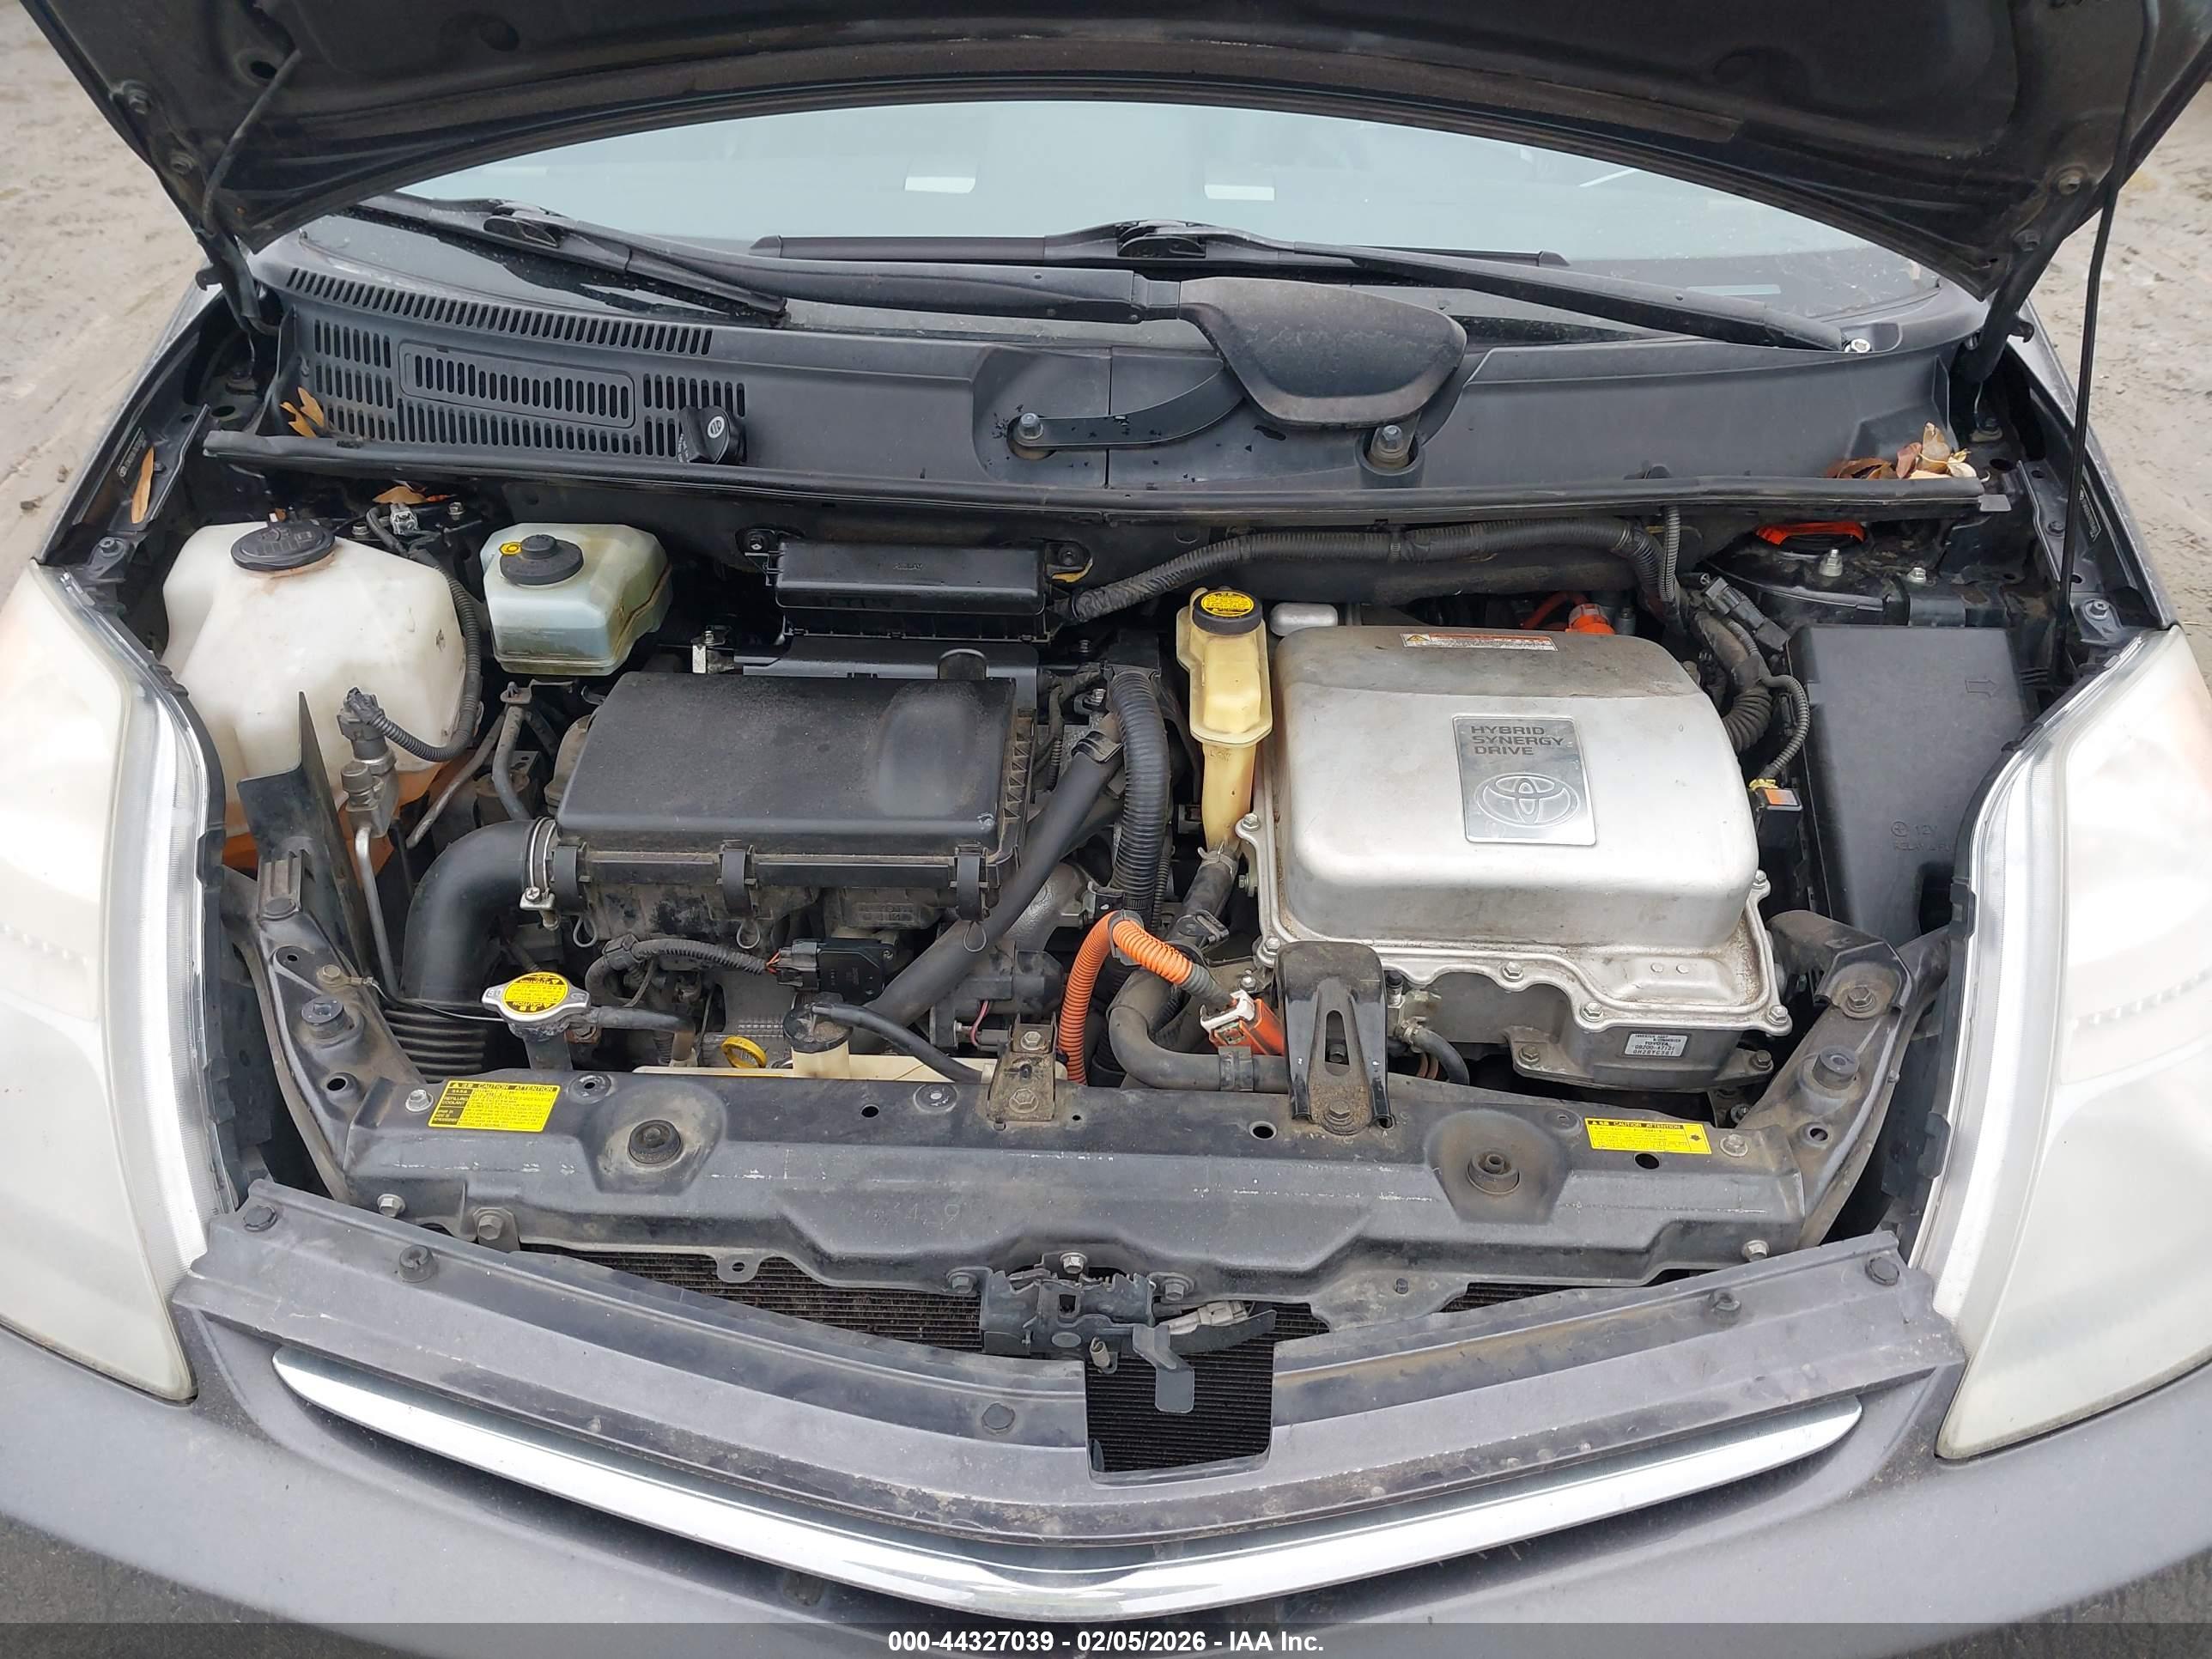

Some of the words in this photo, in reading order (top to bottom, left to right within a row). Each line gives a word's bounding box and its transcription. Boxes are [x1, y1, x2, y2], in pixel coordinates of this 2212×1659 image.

[1471, 726, 1545, 735] HYBRID
[1472, 735, 1565, 745] SYNERGY
[1474, 745, 1534, 756] DRIVE
